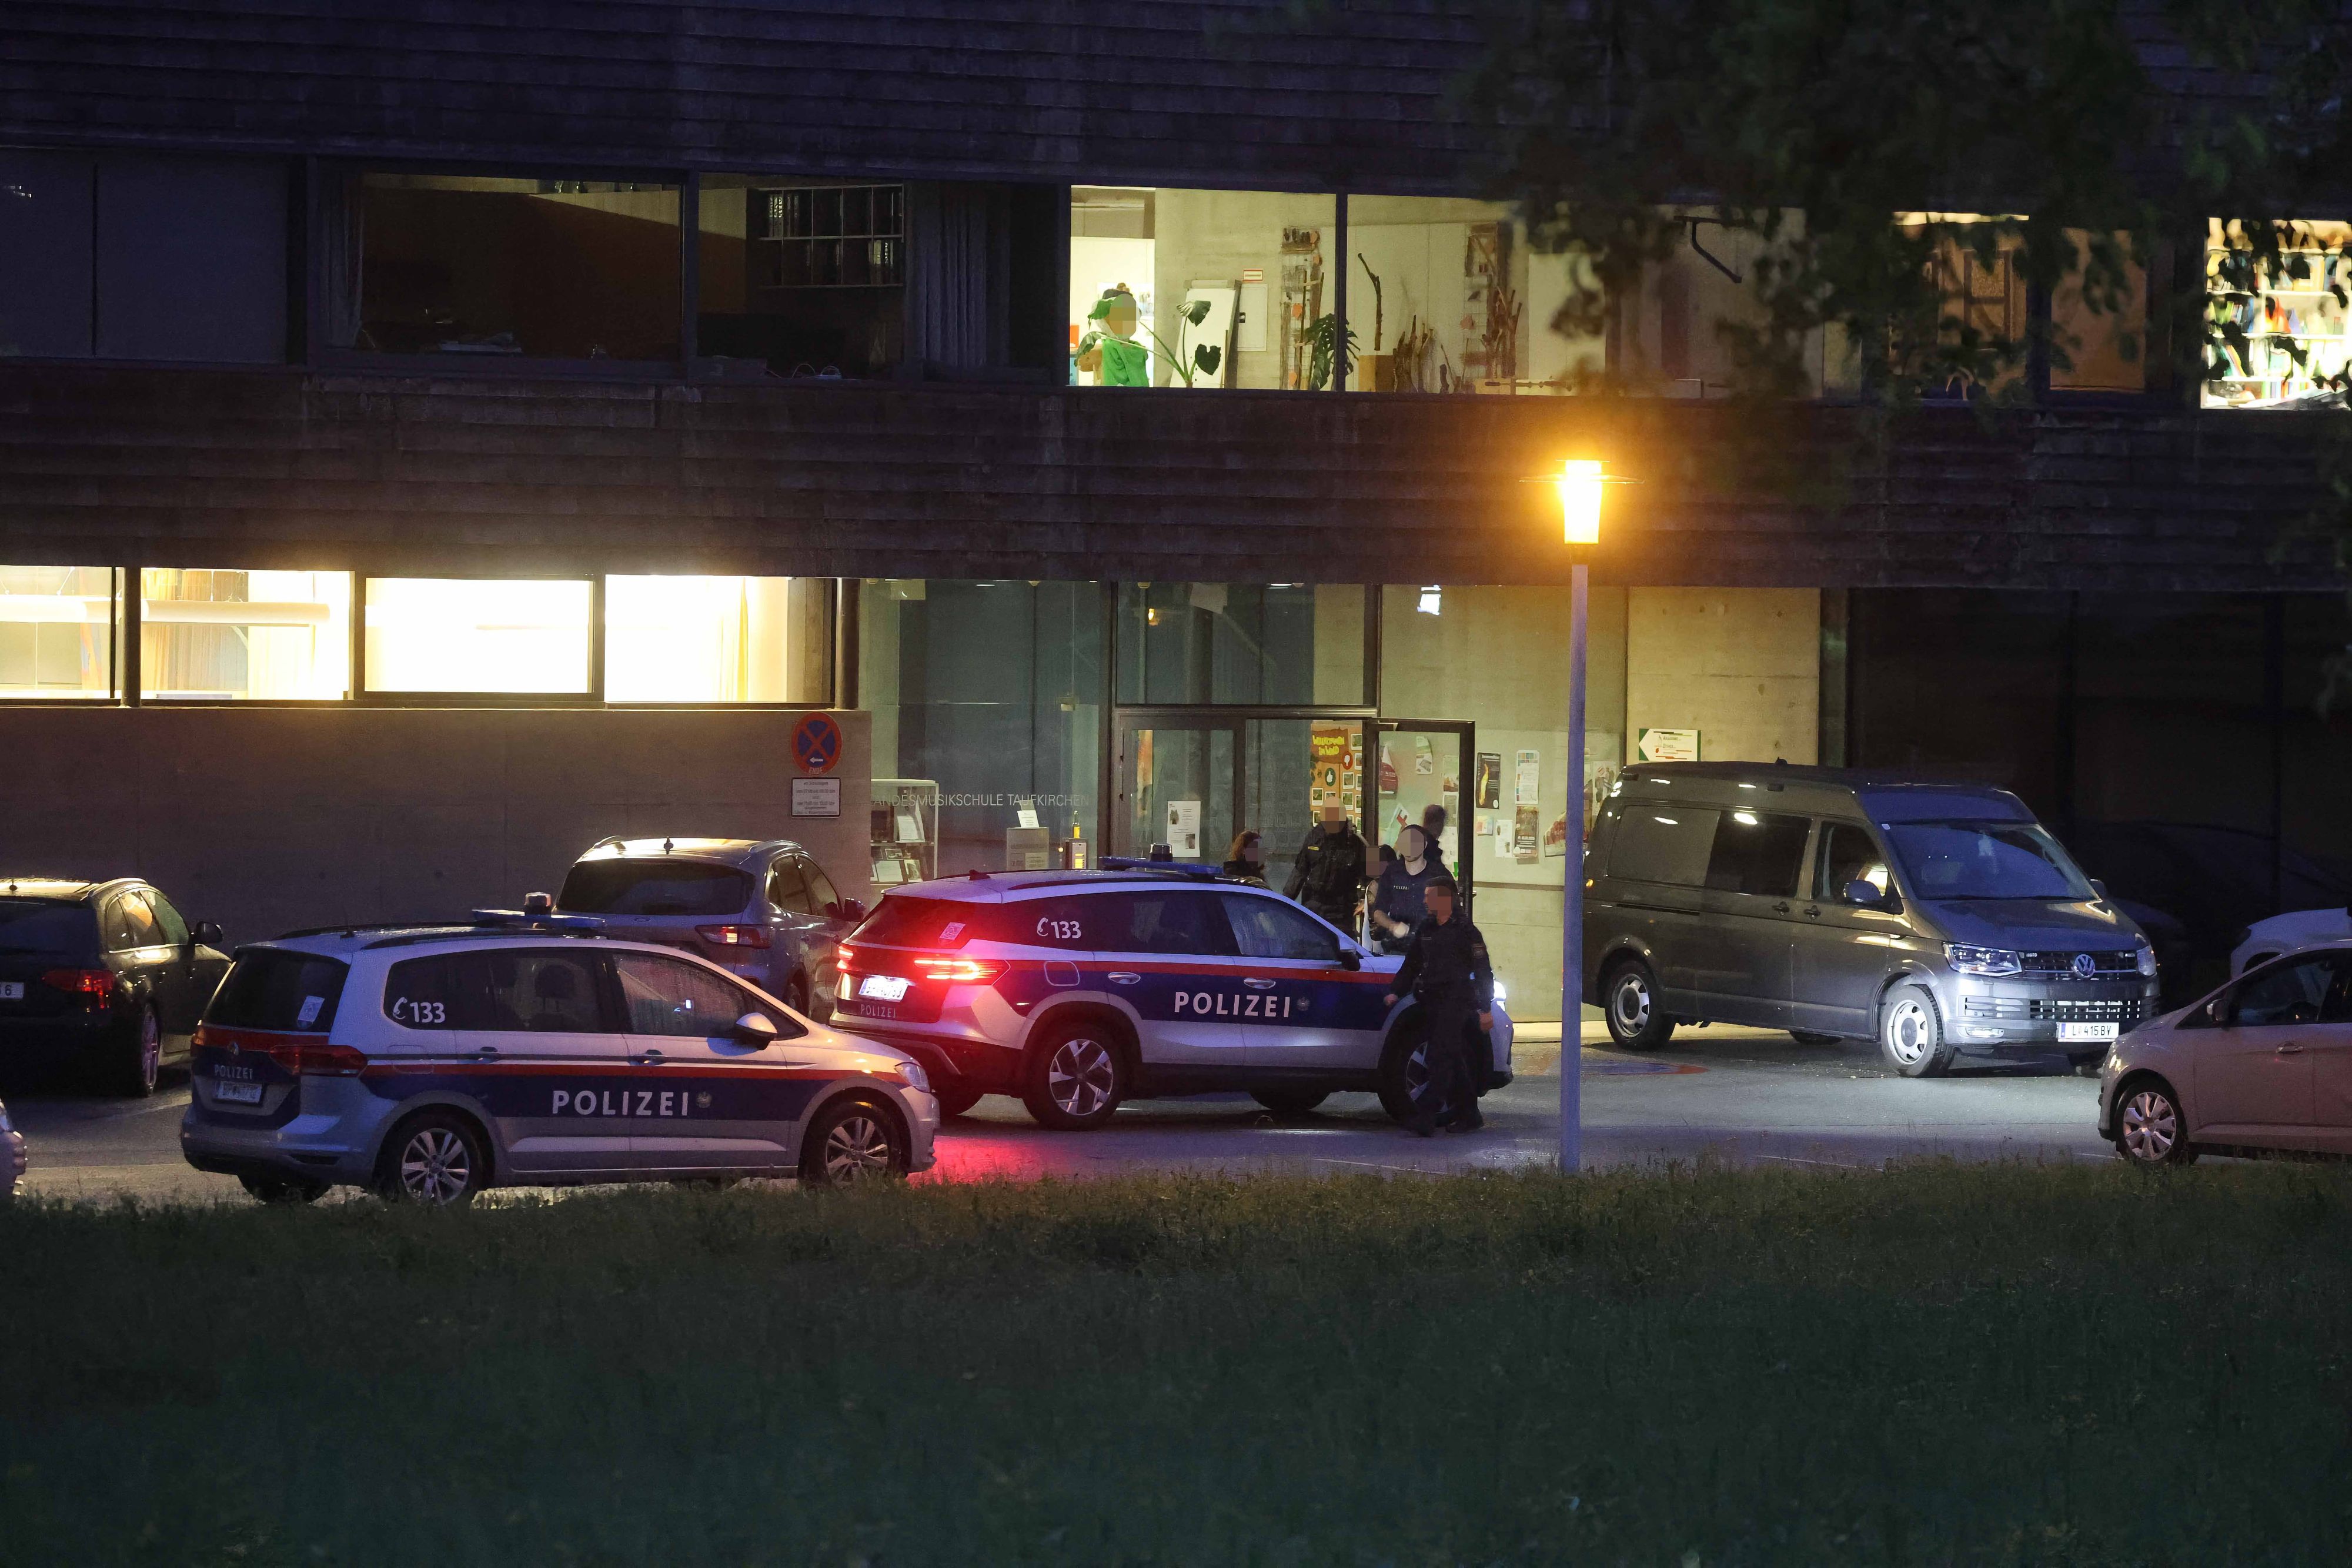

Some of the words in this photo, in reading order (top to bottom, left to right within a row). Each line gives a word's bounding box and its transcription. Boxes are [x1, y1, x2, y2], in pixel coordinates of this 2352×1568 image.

[873, 794, 1003, 807] ANDESMUSIKSCHULE
[1050, 921, 1081, 939] 133
[410, 1002, 446, 1023] 133
[860, 1004, 896, 1018] POLIZEI
[1174, 991, 1290, 1018] POLIZEI
[214, 1064, 253, 1079] POLIZEI
[552, 1090, 689, 1116] POLIZEI
